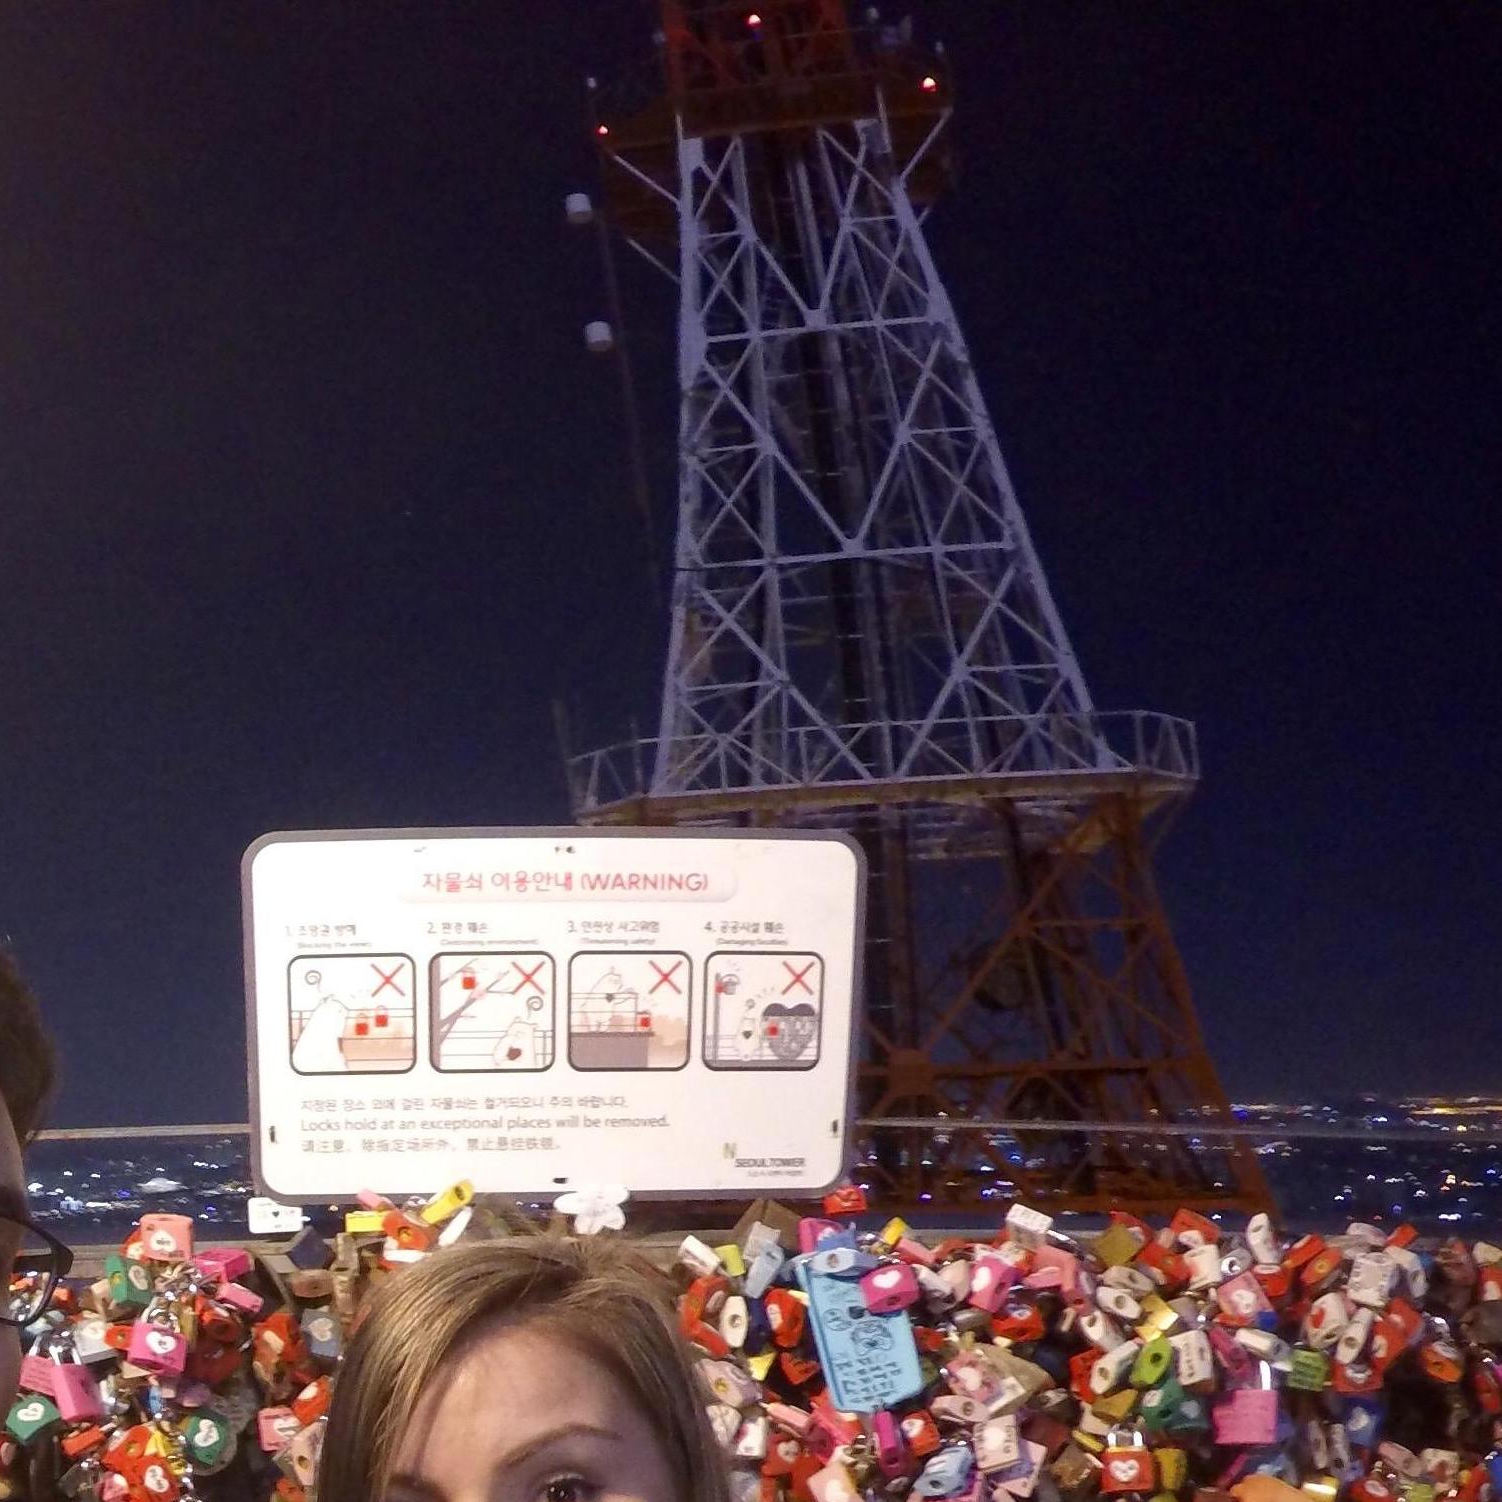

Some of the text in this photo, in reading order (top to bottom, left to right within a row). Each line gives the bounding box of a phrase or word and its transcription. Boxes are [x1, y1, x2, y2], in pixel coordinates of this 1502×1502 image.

[422, 870, 709, 893] 자물쇠 이용안내 (WARNING)
[703, 920, 716, 933] 4.
[300, 1119, 341, 1132] Locks
[380, 1119, 396, 1131] at
[398, 1119, 417, 1131] an
[420, 1116, 504, 1133] exceptional
[506, 1115, 551, 1132] places
[556, 1115, 580, 1128] will
[583, 1115, 602, 1128] be
[605, 1114, 670, 1128] removed.
